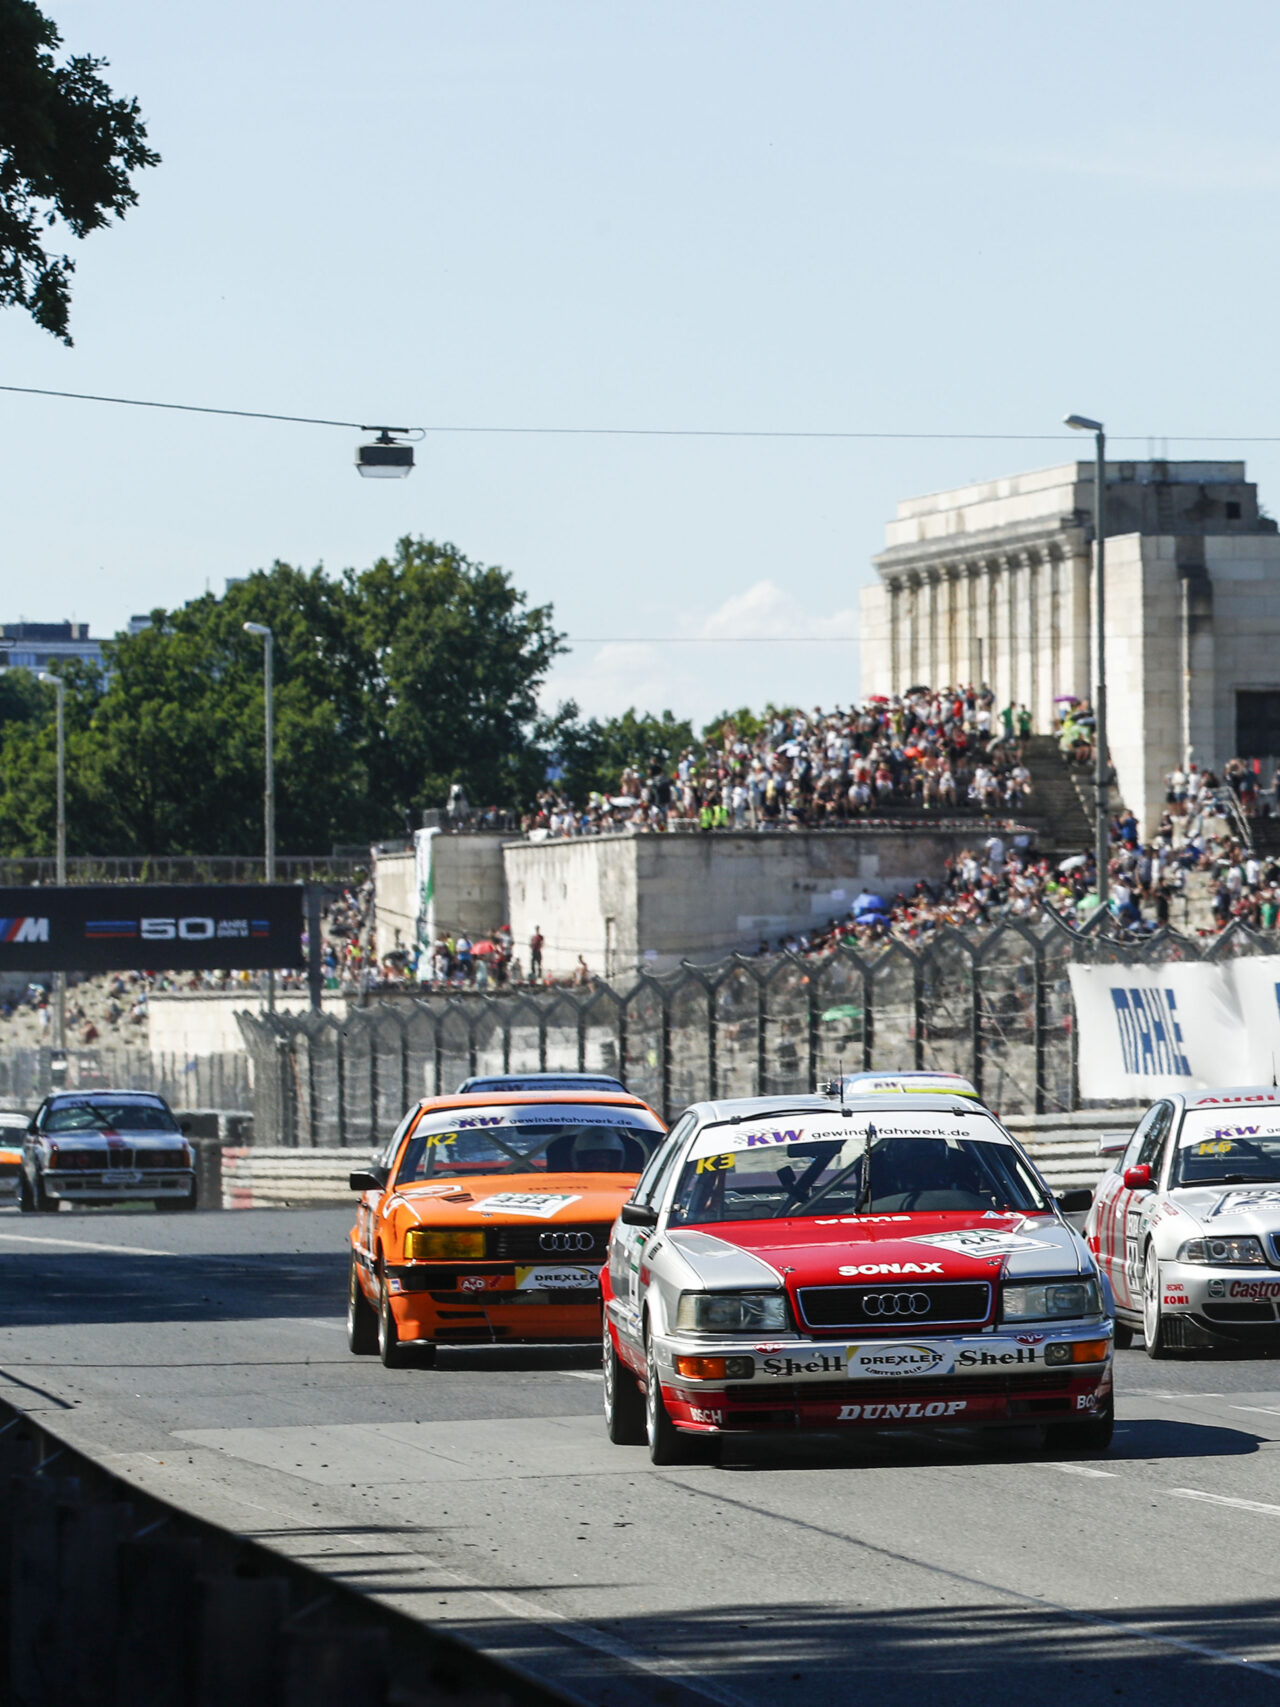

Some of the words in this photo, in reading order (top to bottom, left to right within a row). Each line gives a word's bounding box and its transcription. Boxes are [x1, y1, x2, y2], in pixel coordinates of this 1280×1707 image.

[140, 917, 215, 939] 50
[1110, 988, 1192, 1076] MAHLE
[1196, 1094, 1275, 1105] Audi
[458, 1115, 506, 1128] KW
[510, 1115, 633, 1127] gewindefahrwerk.de
[746, 1129, 805, 1147] KW
[811, 1127, 971, 1140] gewindfahrwerk.de
[1214, 1124, 1261, 1139] KW
[426, 1133, 459, 1148] K2
[1199, 1140, 1233, 1155] K6
[695, 1153, 736, 1174] K3
[960, 1236, 1001, 1246] 44
[838, 1262, 945, 1277] SONAX
[534, 1273, 600, 1282] DREXLER
[859, 1353, 944, 1366] DREXLER
[958, 1347, 1037, 1367] Shell
[763, 1355, 842, 1375] Shell
[865, 1366, 902, 1376] LIMITED
[903, 1365, 923, 1376] SLIP
[836, 1400, 967, 1420] DUNLOP
